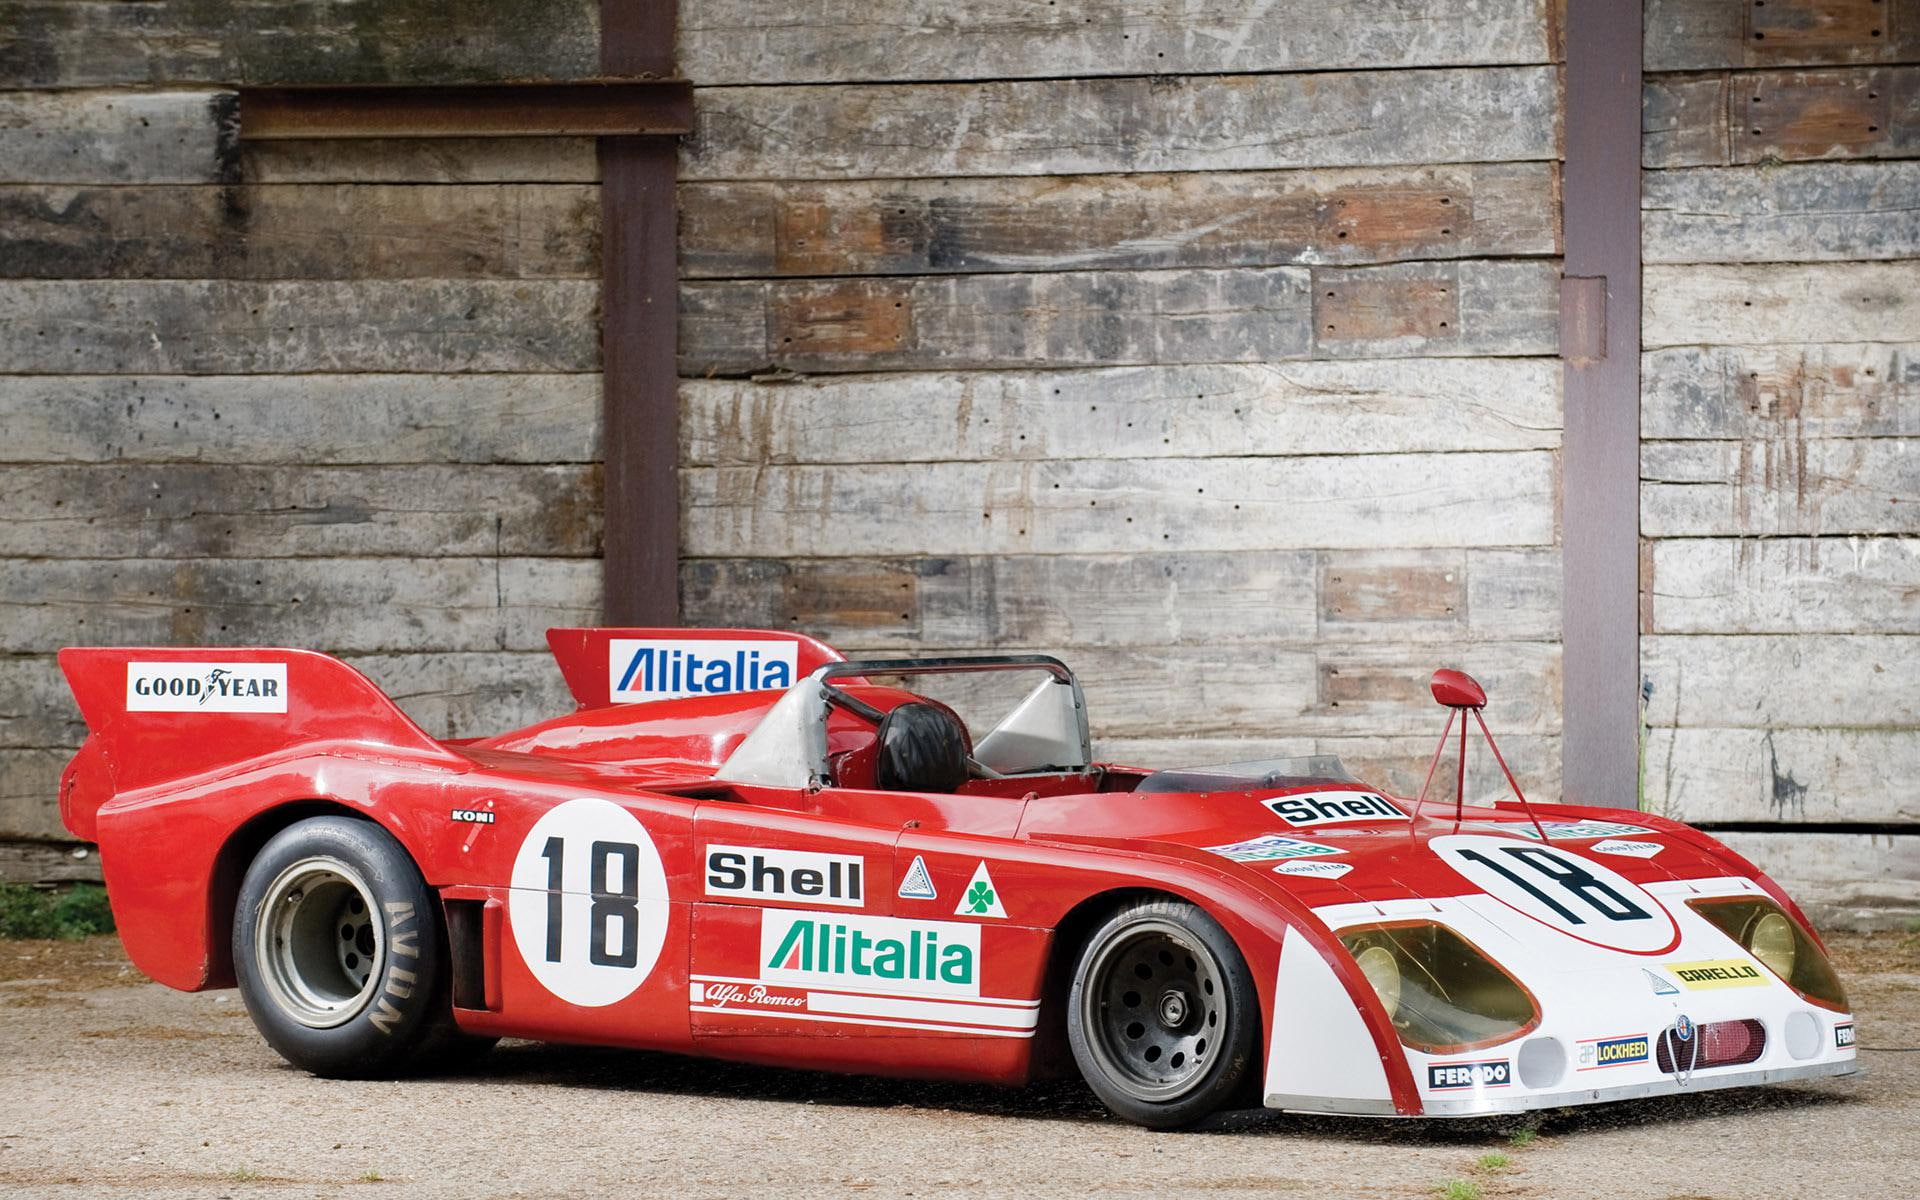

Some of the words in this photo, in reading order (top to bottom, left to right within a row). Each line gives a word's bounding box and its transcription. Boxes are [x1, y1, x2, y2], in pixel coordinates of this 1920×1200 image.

[616, 647, 790, 694] Alitalia
[451, 809, 495, 823] KONI
[1270, 795, 1403, 823] Shell
[707, 851, 861, 900] Shell
[1455, 847, 1653, 925] 18
[541, 836, 640, 969] 18
[367, 901, 420, 1036] AVON
[767, 919, 973, 985] Alitalia
[1676, 965, 1760, 982] CARELLO
[705, 983, 747, 1008] Alfa
[747, 984, 807, 1007] Romeo
[1599, 1041, 1647, 1061] LOCKHEED
[1434, 1065, 1507, 1085] FERODO
